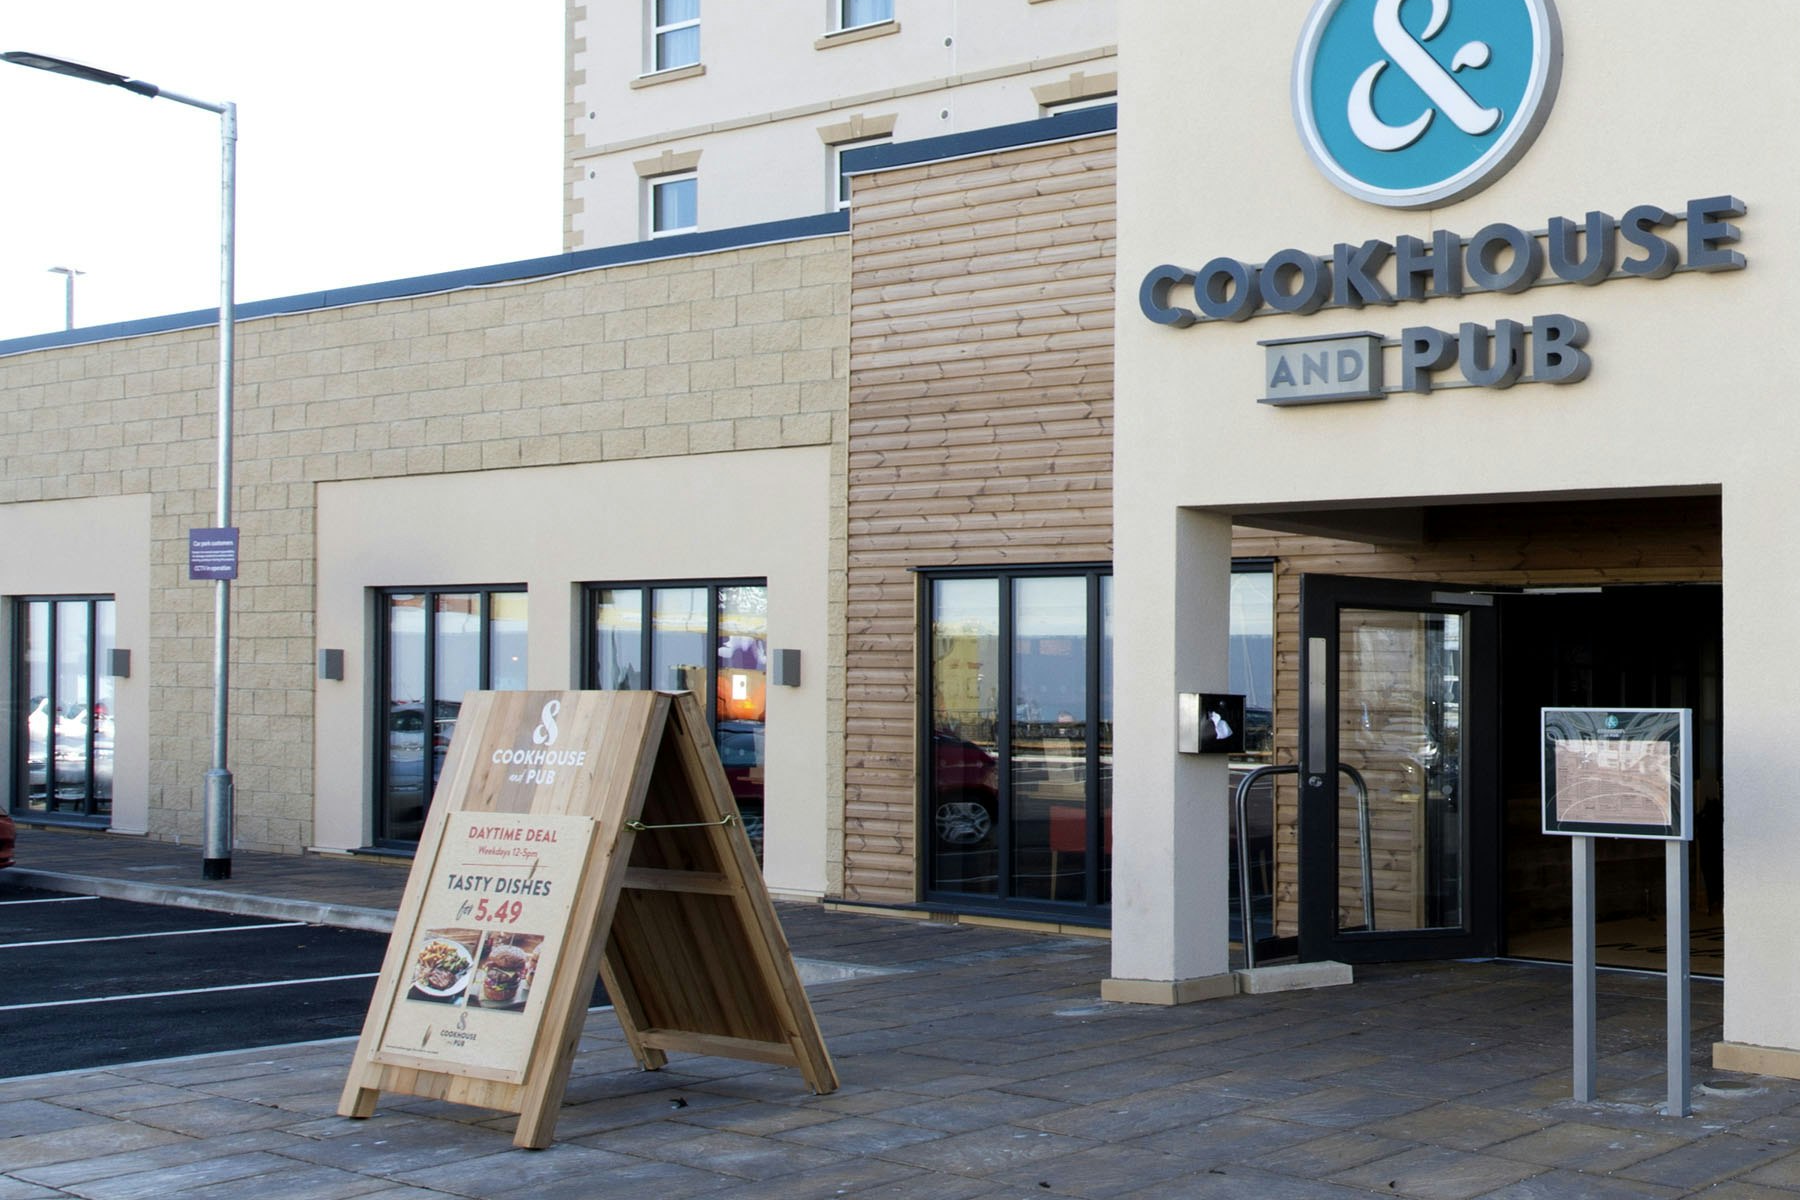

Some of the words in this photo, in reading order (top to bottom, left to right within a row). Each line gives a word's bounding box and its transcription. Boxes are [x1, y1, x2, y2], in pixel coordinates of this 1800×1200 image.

[1139, 195, 1746, 328] COOKHOUSE
[1269, 347, 1365, 388] AND
[1401, 314, 1592, 394] PUB
[492, 749, 586, 767] COOKHOUSE
[525, 769, 556, 785] PUB
[468, 826, 523, 841] DAYTIME
[525, 829, 558, 843] DEAL
[478, 846, 510, 859] Weekdays
[512, 847, 539, 860] 12-5pm
[447, 874, 494, 892] TASTY
[495, 878, 552, 896] DISHES
[456, 900, 473, 921] for
[474, 898, 523, 924] 5.49
[440, 1029, 477, 1041] COOKHOUSE
